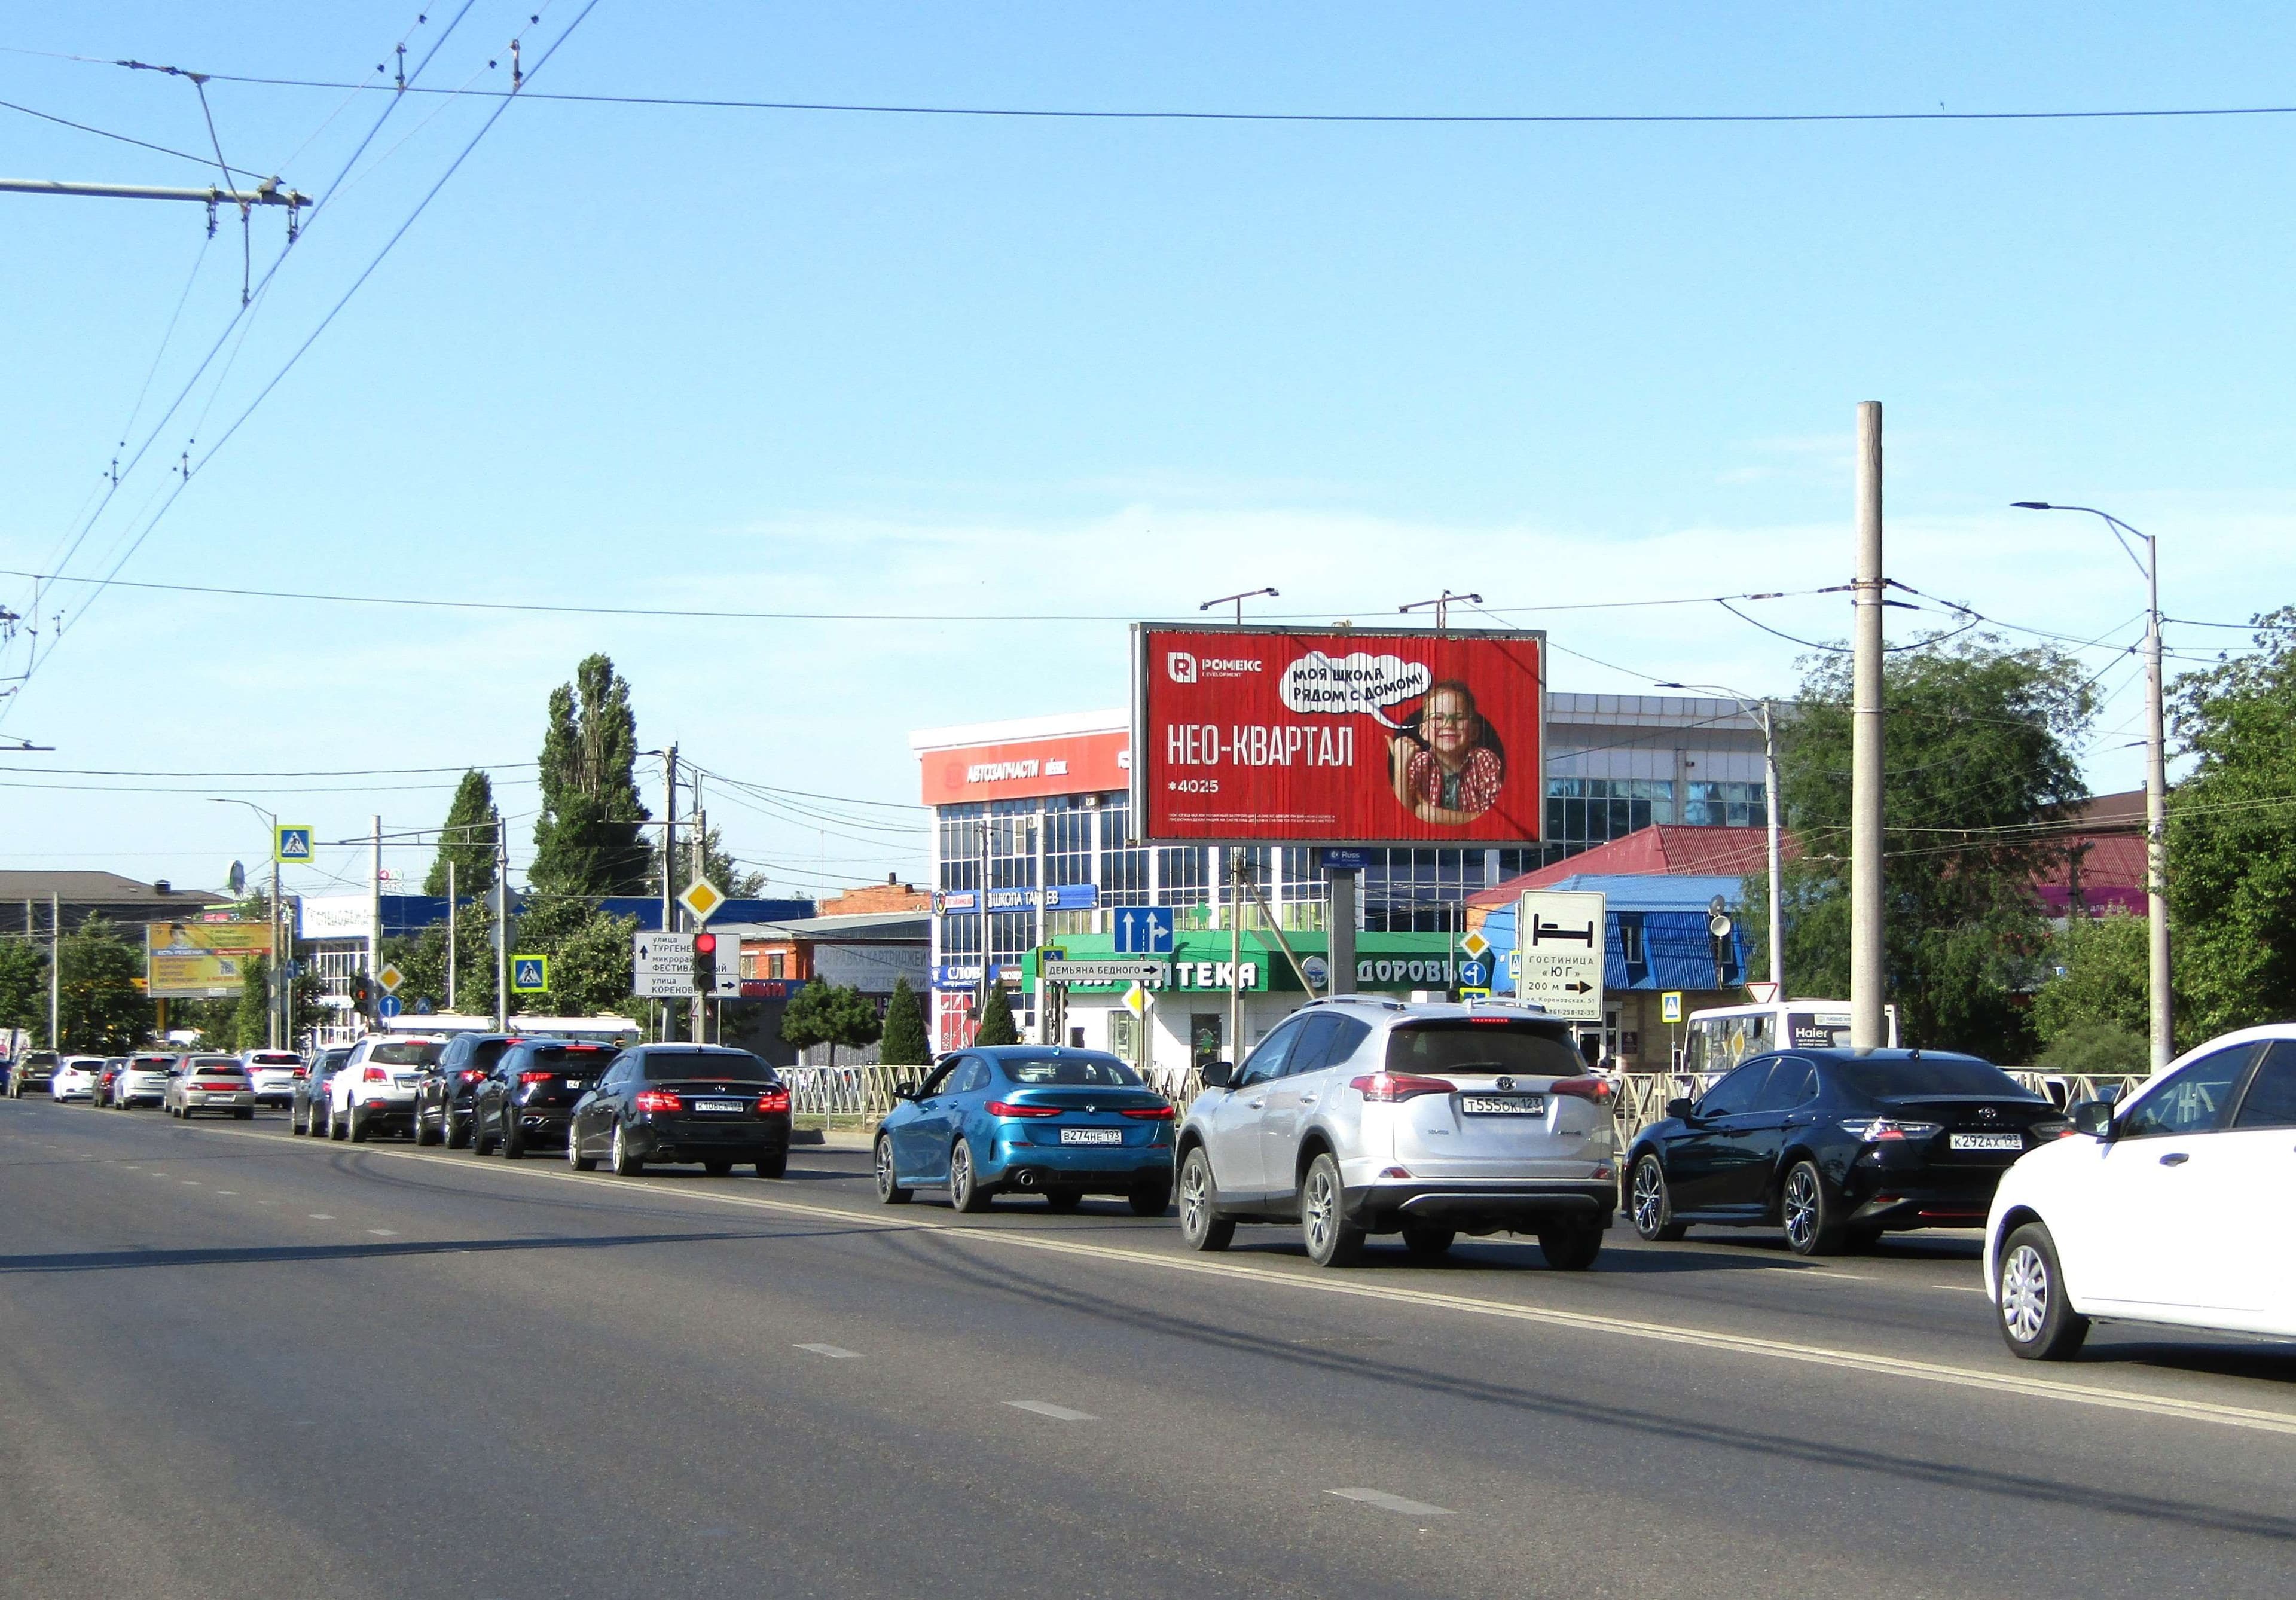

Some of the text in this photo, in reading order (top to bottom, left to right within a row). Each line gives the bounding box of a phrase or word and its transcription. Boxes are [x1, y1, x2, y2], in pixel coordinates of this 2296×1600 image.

[1202, 659, 1262, 672] РОМЕКС
[1293, 668, 1384, 683] МОЯ ШКОЛА
[1294, 673, 1423, 702] РЯДОМ С ДОМОМ!
[1168, 724, 1353, 766] НЕО-КВАРТАЛ
[967, 759, 1040, 783] АВТОЗАПЧАСТИ
[993, 890, 1059, 907] ШКОЛА ТАНЕВ
[1529, 956, 1594, 965] ГОСТИНИЦА
[652, 964, 727, 972] ФЕСТИВАЫЙ
[1049, 966, 1140, 976] ДЕМЬЯНА БЕДНОГО
[1528, 982, 1547, 990] 200
[1795, 1027, 1828, 1038] Haier
[1468, 1098, 1540, 1112] Т555ОК 123
[1064, 1130, 1120, 1141] В274НЕ 193
[1955, 1135, 2019, 1147] К292АХ 193
